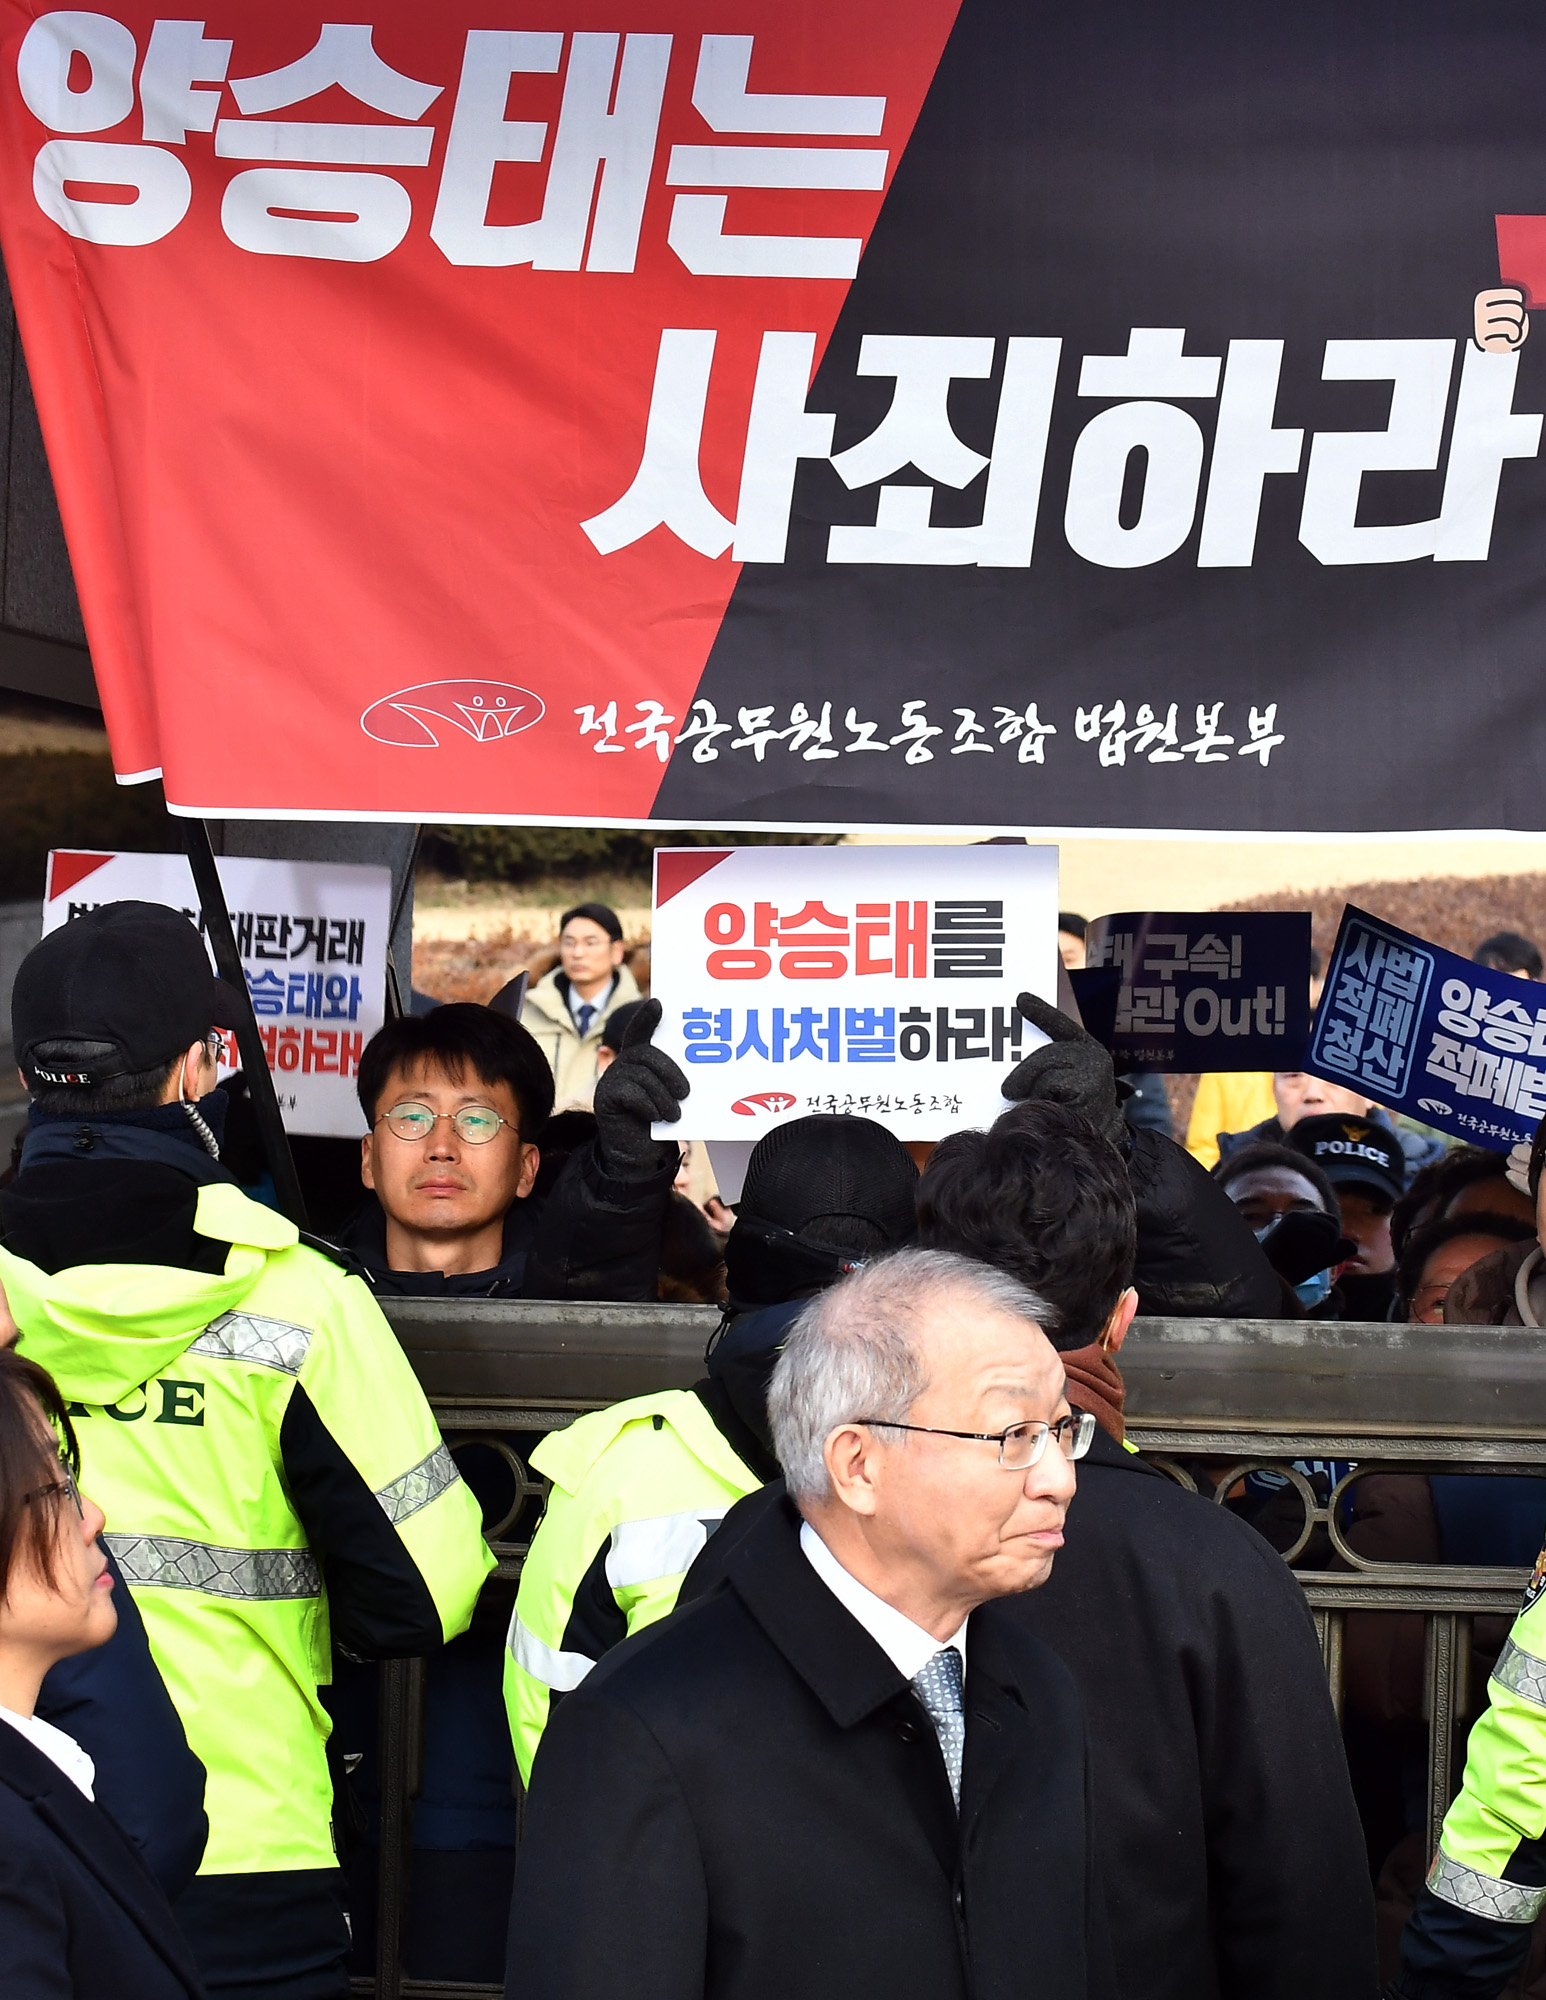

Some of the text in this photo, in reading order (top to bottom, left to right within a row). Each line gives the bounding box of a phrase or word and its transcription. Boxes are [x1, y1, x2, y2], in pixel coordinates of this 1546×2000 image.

[17, 10, 889, 278] 양승태는
[580, 327, 1544, 568] 사죄하라
[573, 699, 1286, 767] 전국공무원노동조합 법원본부
[704, 901, 1006, 980] 양승태를
[1144, 933, 1242, 980] 구속!
[1344, 931, 1425, 1003] 사법
[241, 968, 363, 1021] 승태와
[1335, 973, 1415, 1047] 적폐
[682, 1007, 1023, 1063] 형사처벌하라!
[1322, 1018, 1405, 1090] 청산
[34, 1066, 90, 1084] POLICE
[806, 1093, 963, 1115] 전국공무원노동조합
[1314, 1140, 1389, 1168] POLICE
